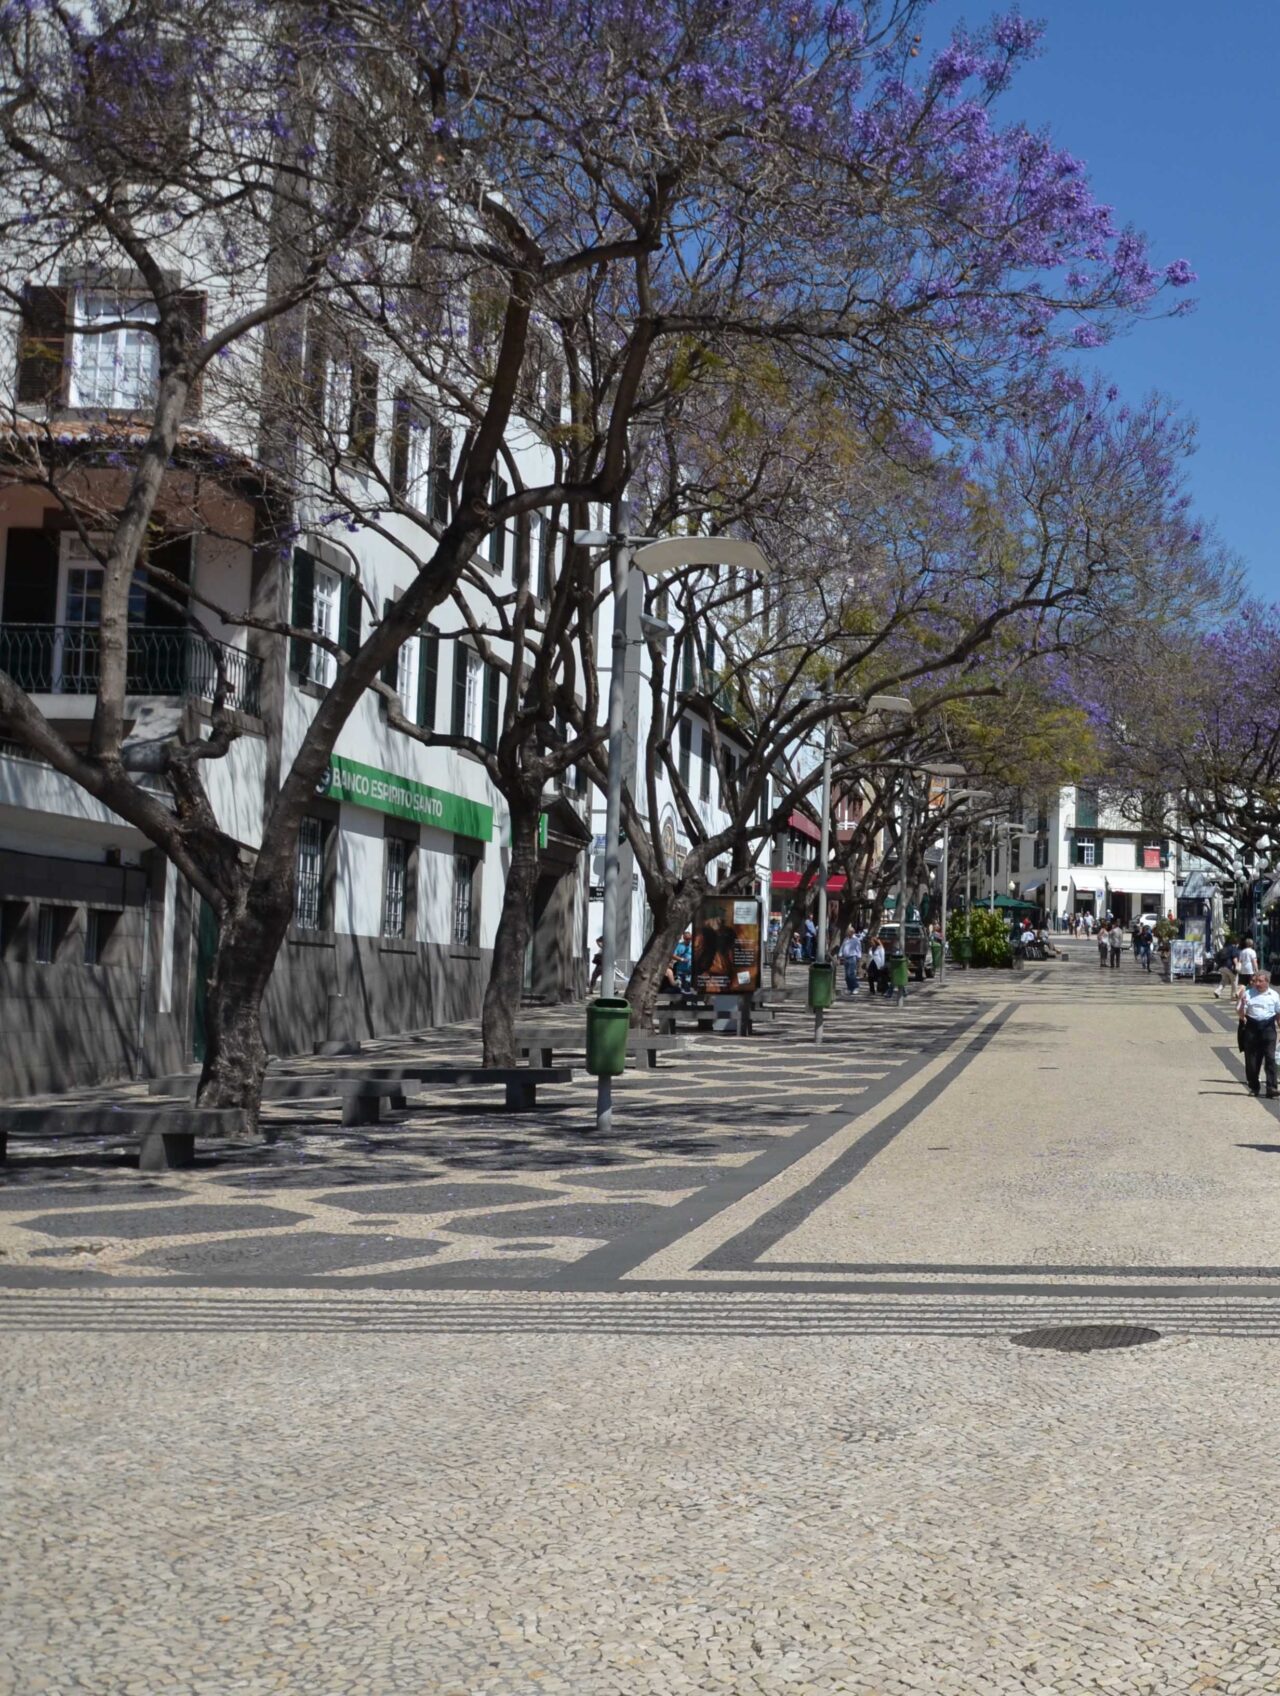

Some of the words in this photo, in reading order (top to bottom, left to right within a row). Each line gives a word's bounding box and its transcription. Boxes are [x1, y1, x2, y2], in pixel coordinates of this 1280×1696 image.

[332, 768, 369, 796] BANCO
[371, 780, 413, 808] ESPIRITO
[413, 795, 443, 818] SANTO
